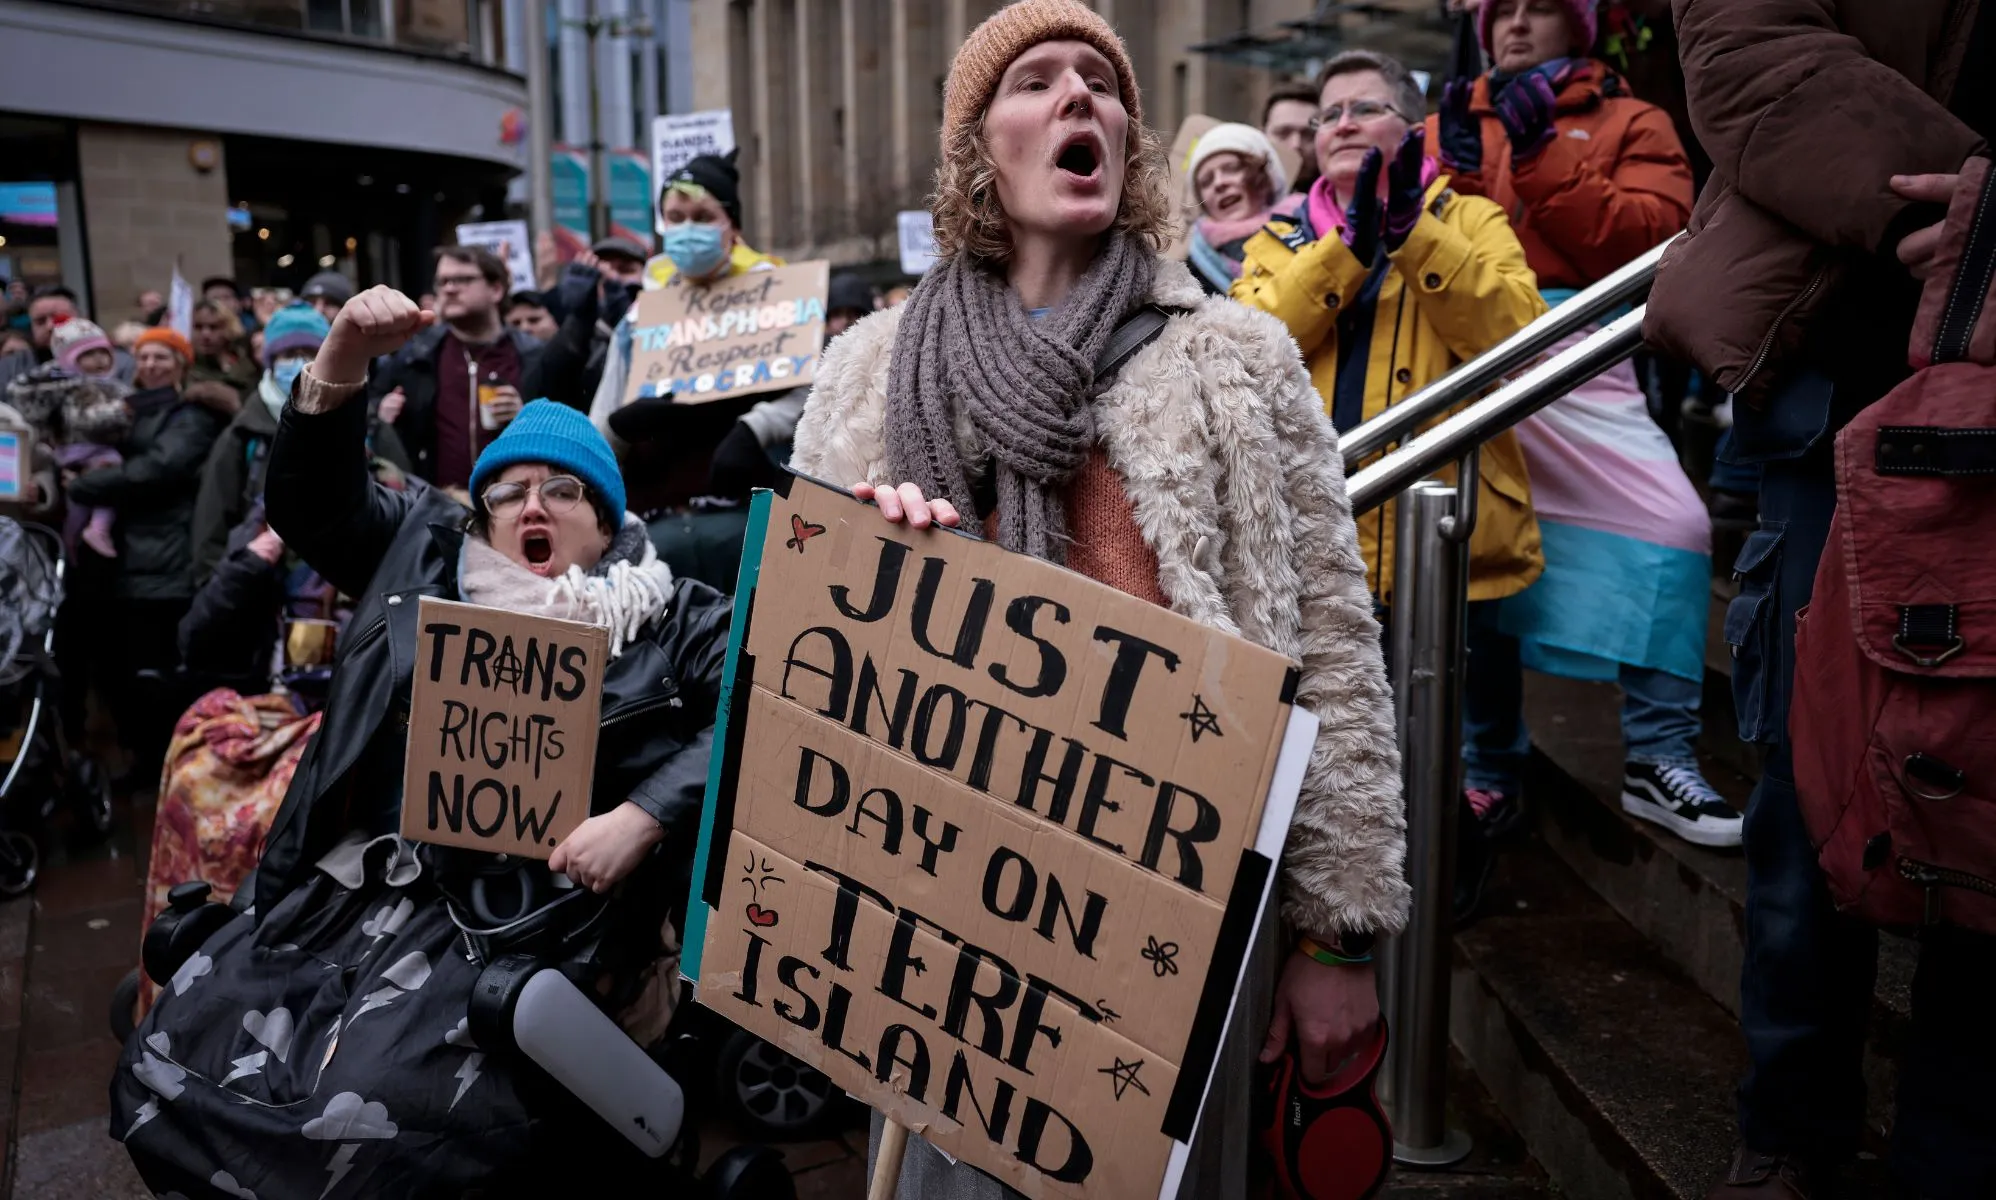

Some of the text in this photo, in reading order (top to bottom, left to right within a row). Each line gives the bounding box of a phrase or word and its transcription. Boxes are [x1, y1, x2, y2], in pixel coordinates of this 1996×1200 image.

[631, 297, 826, 352] TRANSPHOBIA
[681, 276, 783, 315] Reject
[638, 354, 812, 398] DEMOCRACY
[668, 332, 796, 377] Respect
[425, 623, 588, 702] TRANS
[828, 536, 1182, 742] JUST
[781, 626, 1221, 894] ANOTHER
[427, 771, 562, 847] NOW.
[793, 744, 1110, 961] DAY ON
[803, 859, 1104, 1076] TERF
[732, 928, 1094, 1185] ISLAND
